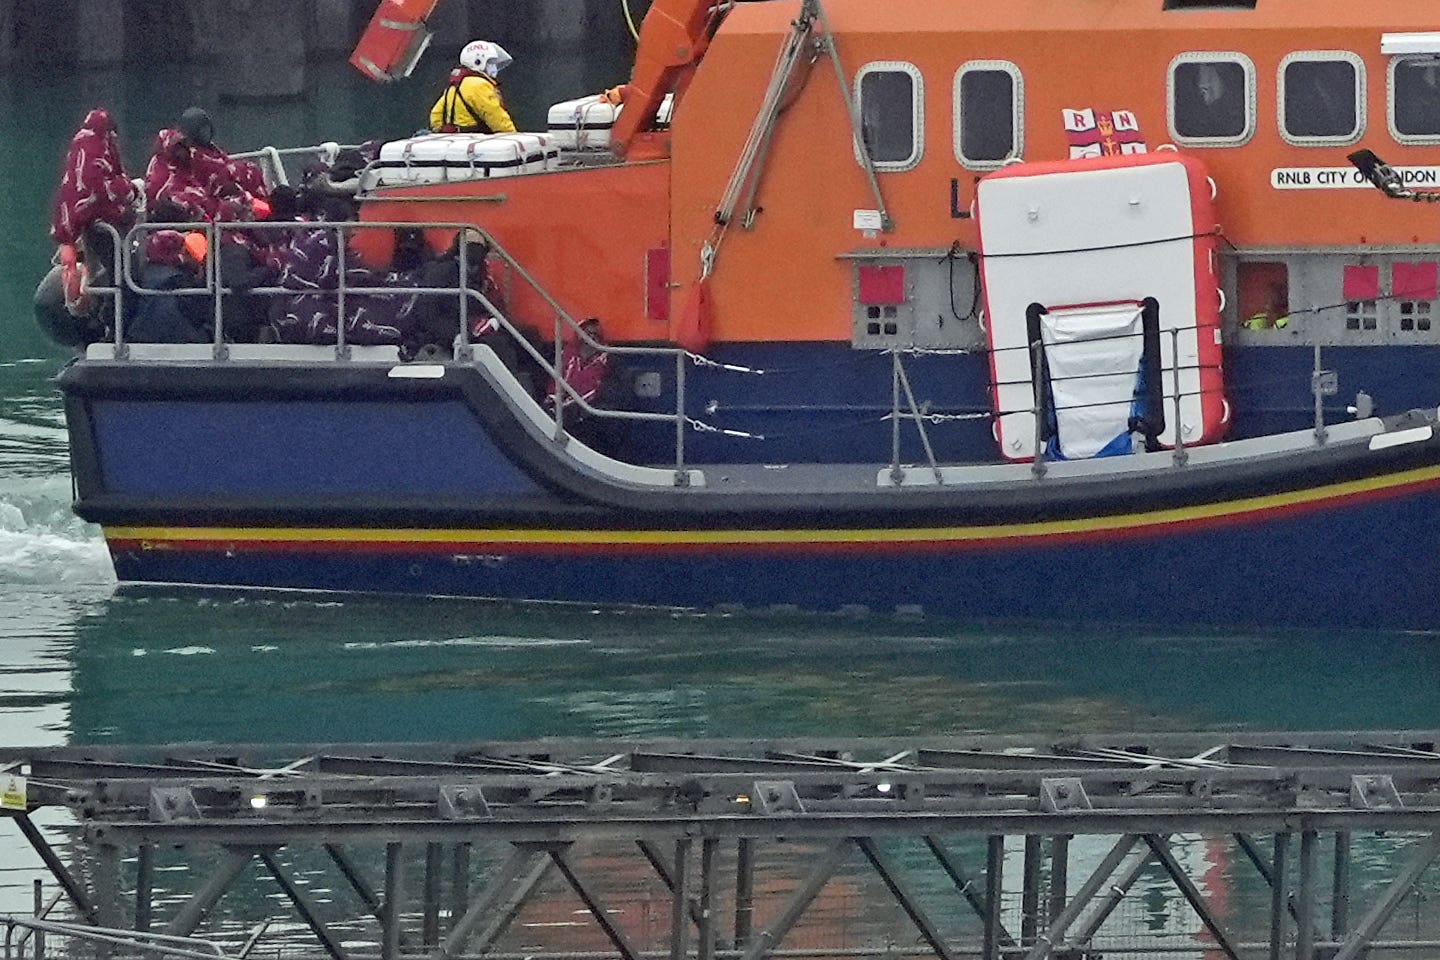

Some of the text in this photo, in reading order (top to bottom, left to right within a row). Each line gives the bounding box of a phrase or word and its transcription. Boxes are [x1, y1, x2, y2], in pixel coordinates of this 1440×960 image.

[1073, 112, 1132, 128] R N
[1277, 171, 1311, 185] RNLB
[1317, 171, 1347, 185] CITY
